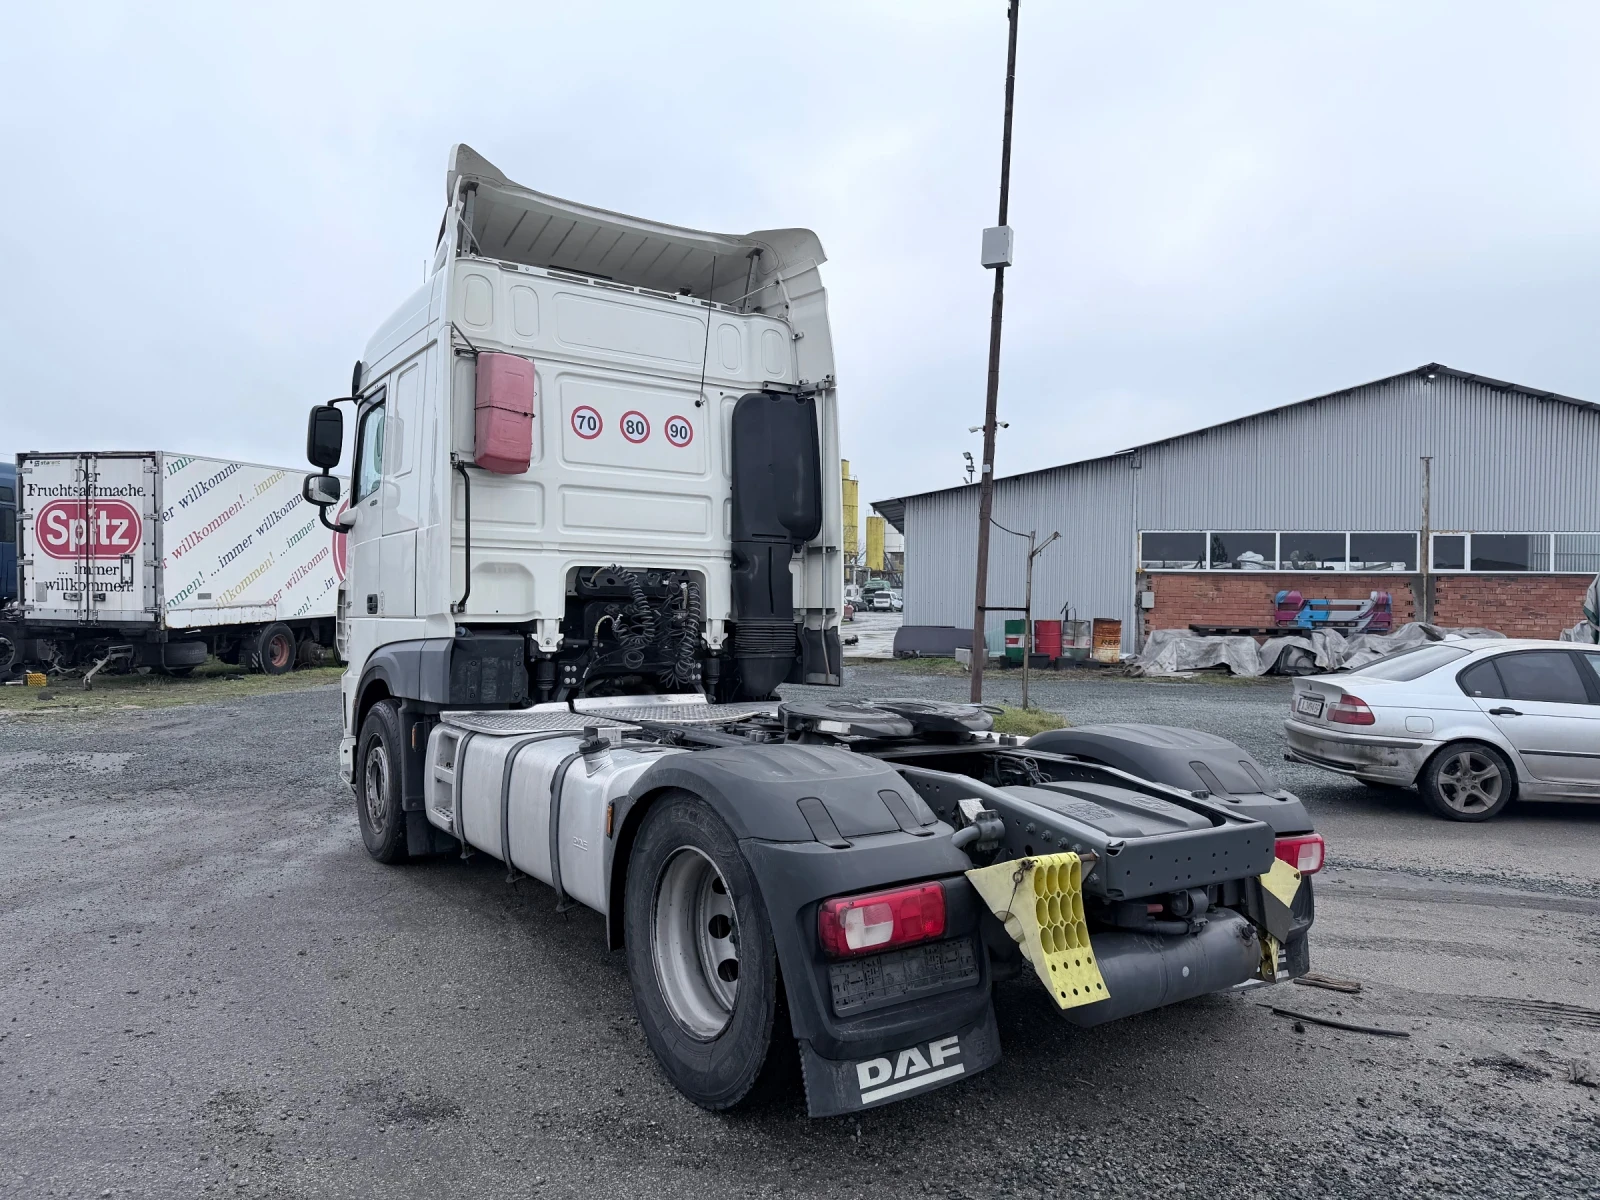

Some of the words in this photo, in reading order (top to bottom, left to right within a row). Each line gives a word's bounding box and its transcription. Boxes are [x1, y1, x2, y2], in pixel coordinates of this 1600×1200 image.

[576, 415, 596, 430] 70
[626, 420, 645, 435] 80
[670, 424, 688, 440] 90
[74, 468, 100, 482] Der
[178, 463, 244, 509] willkomme
[46, 507, 129, 552] Spitz
[256, 493, 304, 536] willkomm
[74, 562, 119, 575] immer
[214, 551, 275, 608] illkommen!
[856, 1035, 960, 1090] DAF
